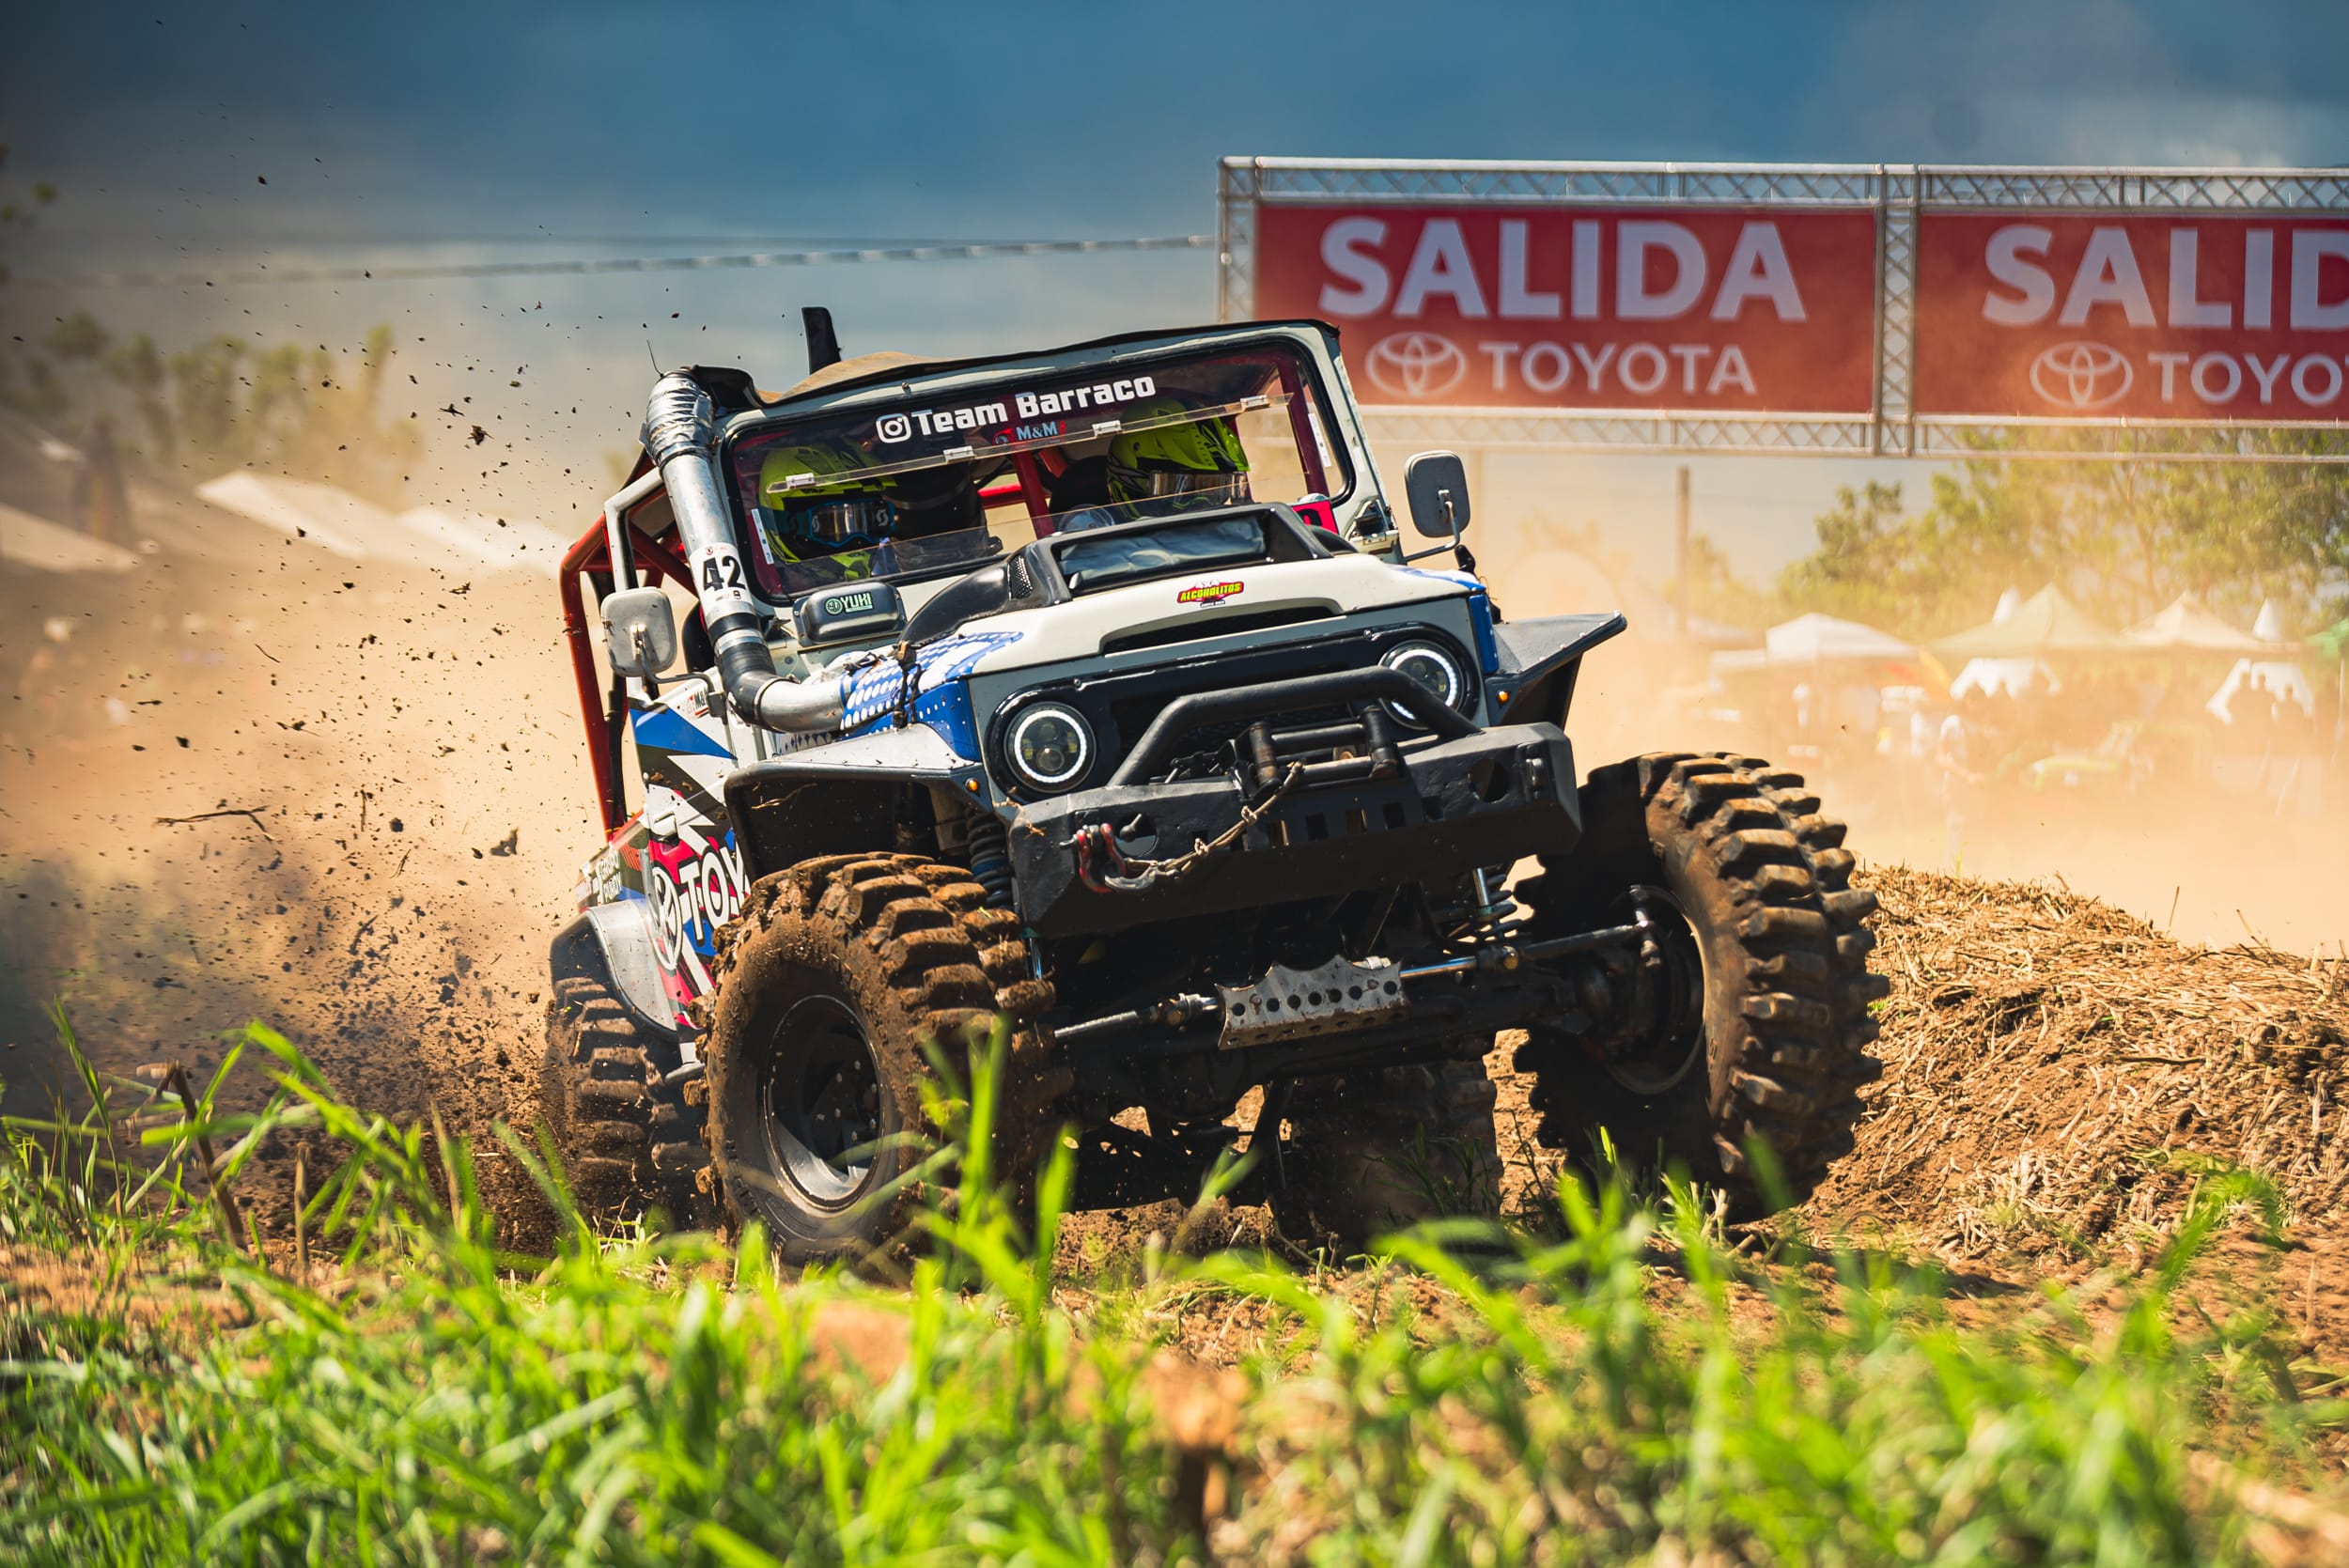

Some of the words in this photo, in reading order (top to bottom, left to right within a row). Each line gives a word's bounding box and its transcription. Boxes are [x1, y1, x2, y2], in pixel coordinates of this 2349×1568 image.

[1317, 216, 1808, 322] SALIDA
[1478, 341, 1758, 396] TOYOTA
[2147, 350, 2349, 406] TOYO
[910, 401, 1009, 436] Team
[1015, 376, 1157, 419] Barraco
[1016, 421, 1058, 441] M&M
[703, 555, 746, 592] 42
[1180, 582, 1241, 601] ALCOHOLITOS
[678, 837, 751, 941] TOY
